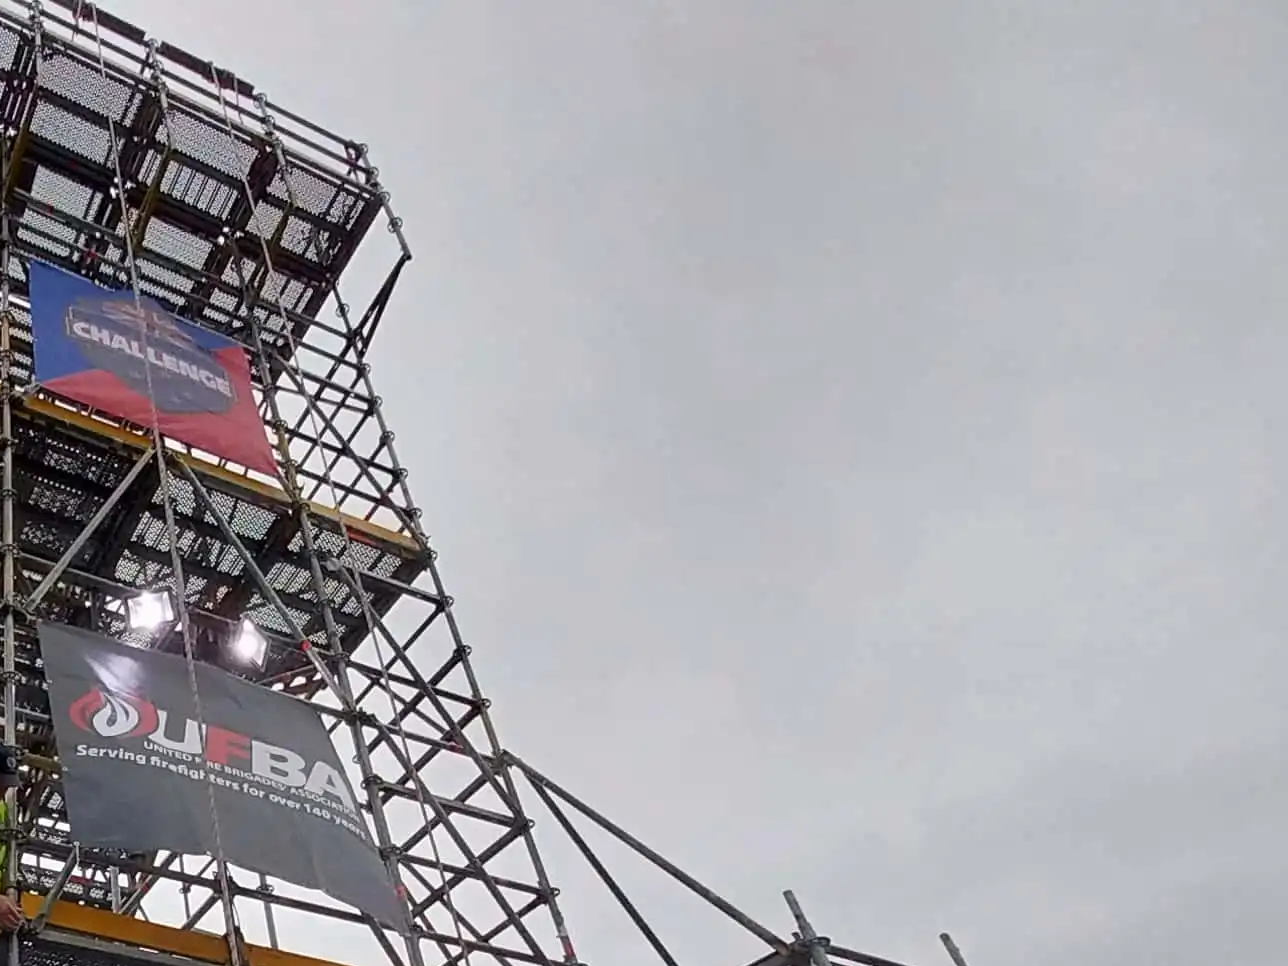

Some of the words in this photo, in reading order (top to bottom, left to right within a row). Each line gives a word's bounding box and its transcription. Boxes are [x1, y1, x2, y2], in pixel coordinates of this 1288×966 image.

[76, 744, 147, 766] Serving
[242, 782, 265, 799] for
[268, 793, 302, 811] over
[143, 740, 193, 763] UNITED
[194, 755, 222, 772] FRE
[148, 708, 355, 813] UFBA
